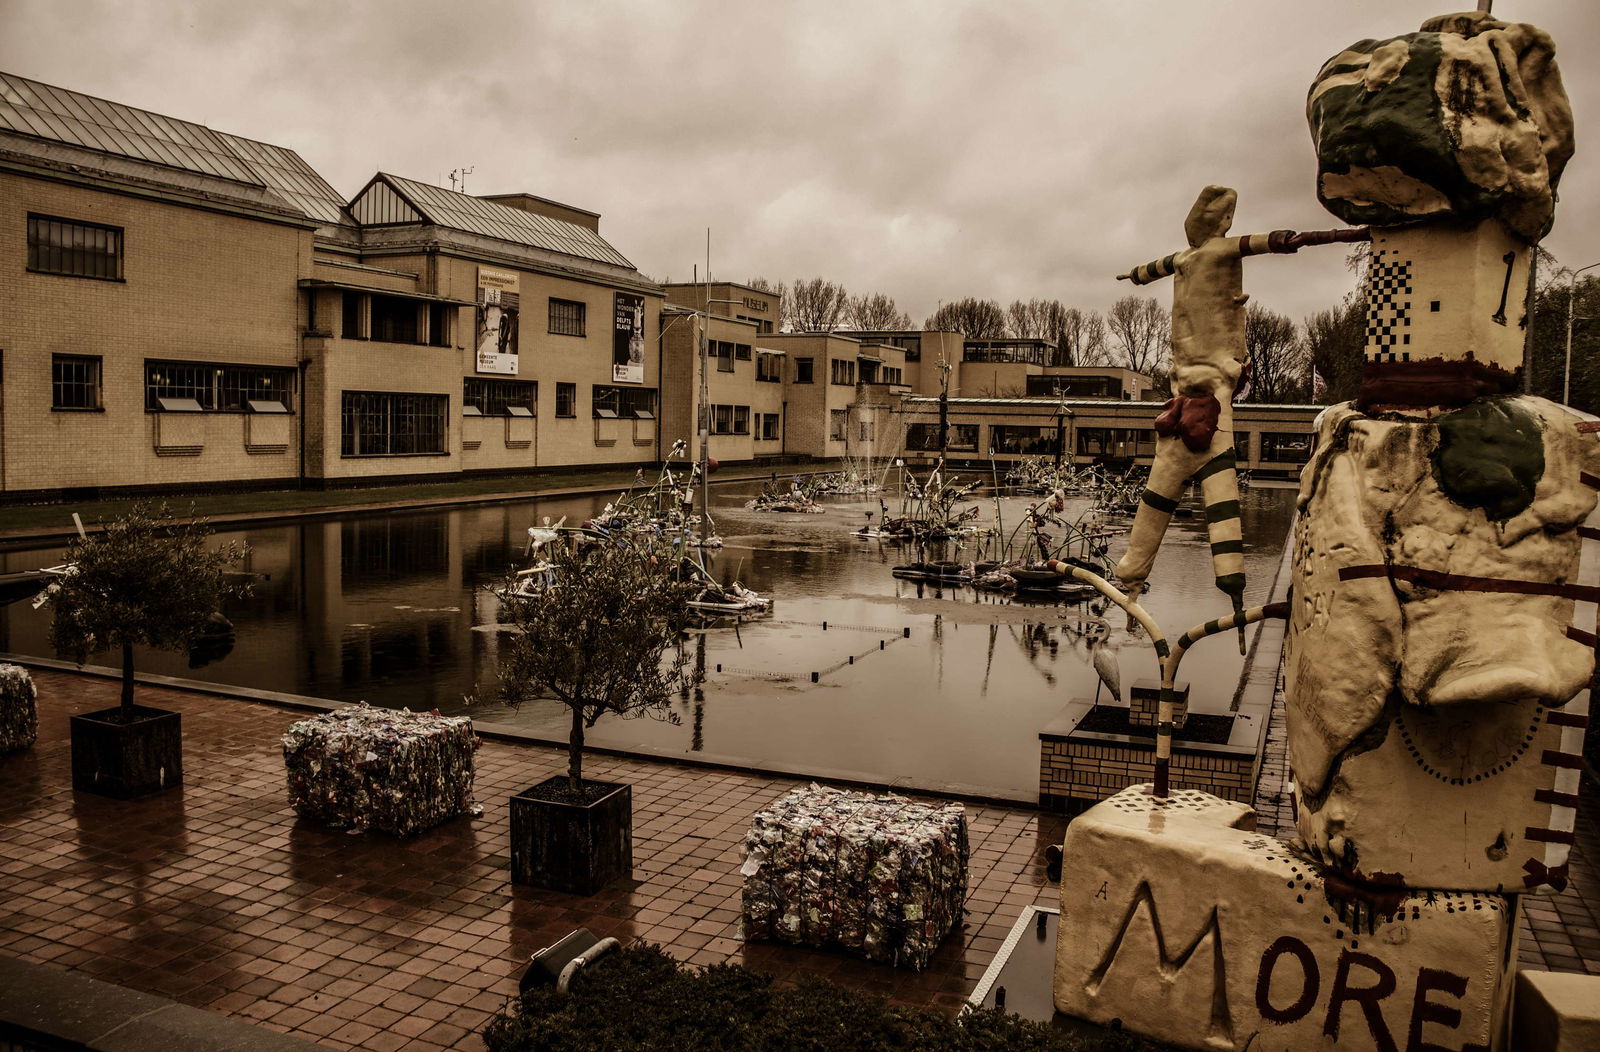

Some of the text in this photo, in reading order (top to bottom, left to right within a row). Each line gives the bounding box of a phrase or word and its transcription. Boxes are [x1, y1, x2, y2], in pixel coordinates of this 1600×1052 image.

[616, 304, 634, 312] WONDER
[743, 296, 769, 312] MUSEUM
[616, 316, 631, 324] DELFTS
[1084, 880, 1491, 1052] MORE
